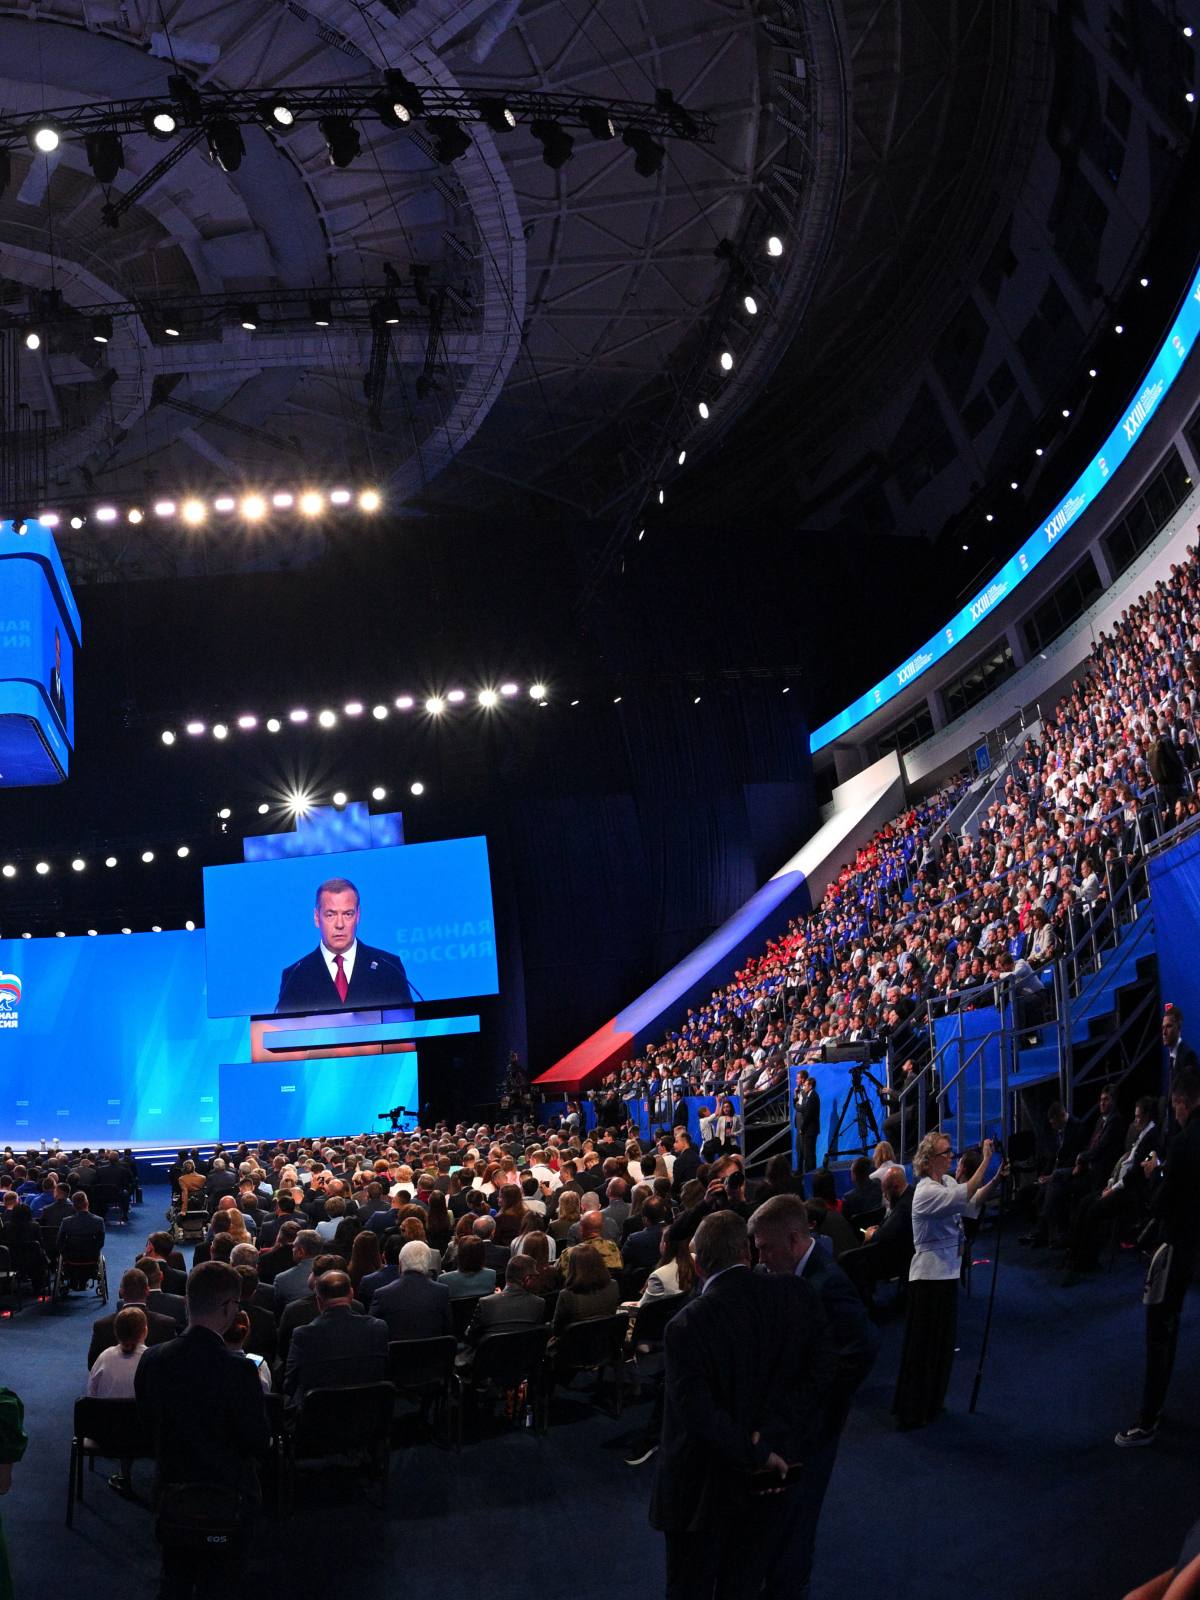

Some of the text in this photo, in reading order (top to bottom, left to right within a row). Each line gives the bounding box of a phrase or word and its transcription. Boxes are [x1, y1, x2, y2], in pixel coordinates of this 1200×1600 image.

[1122, 400, 1147, 441] XXIII
[1044, 507, 1068, 542] XXIII
[970, 593, 991, 621] XXIII
[897, 662, 916, 685] XXIII
[396, 920, 492, 944] ЕДИНАЯ
[399, 941, 493, 963] РОССИЯ
